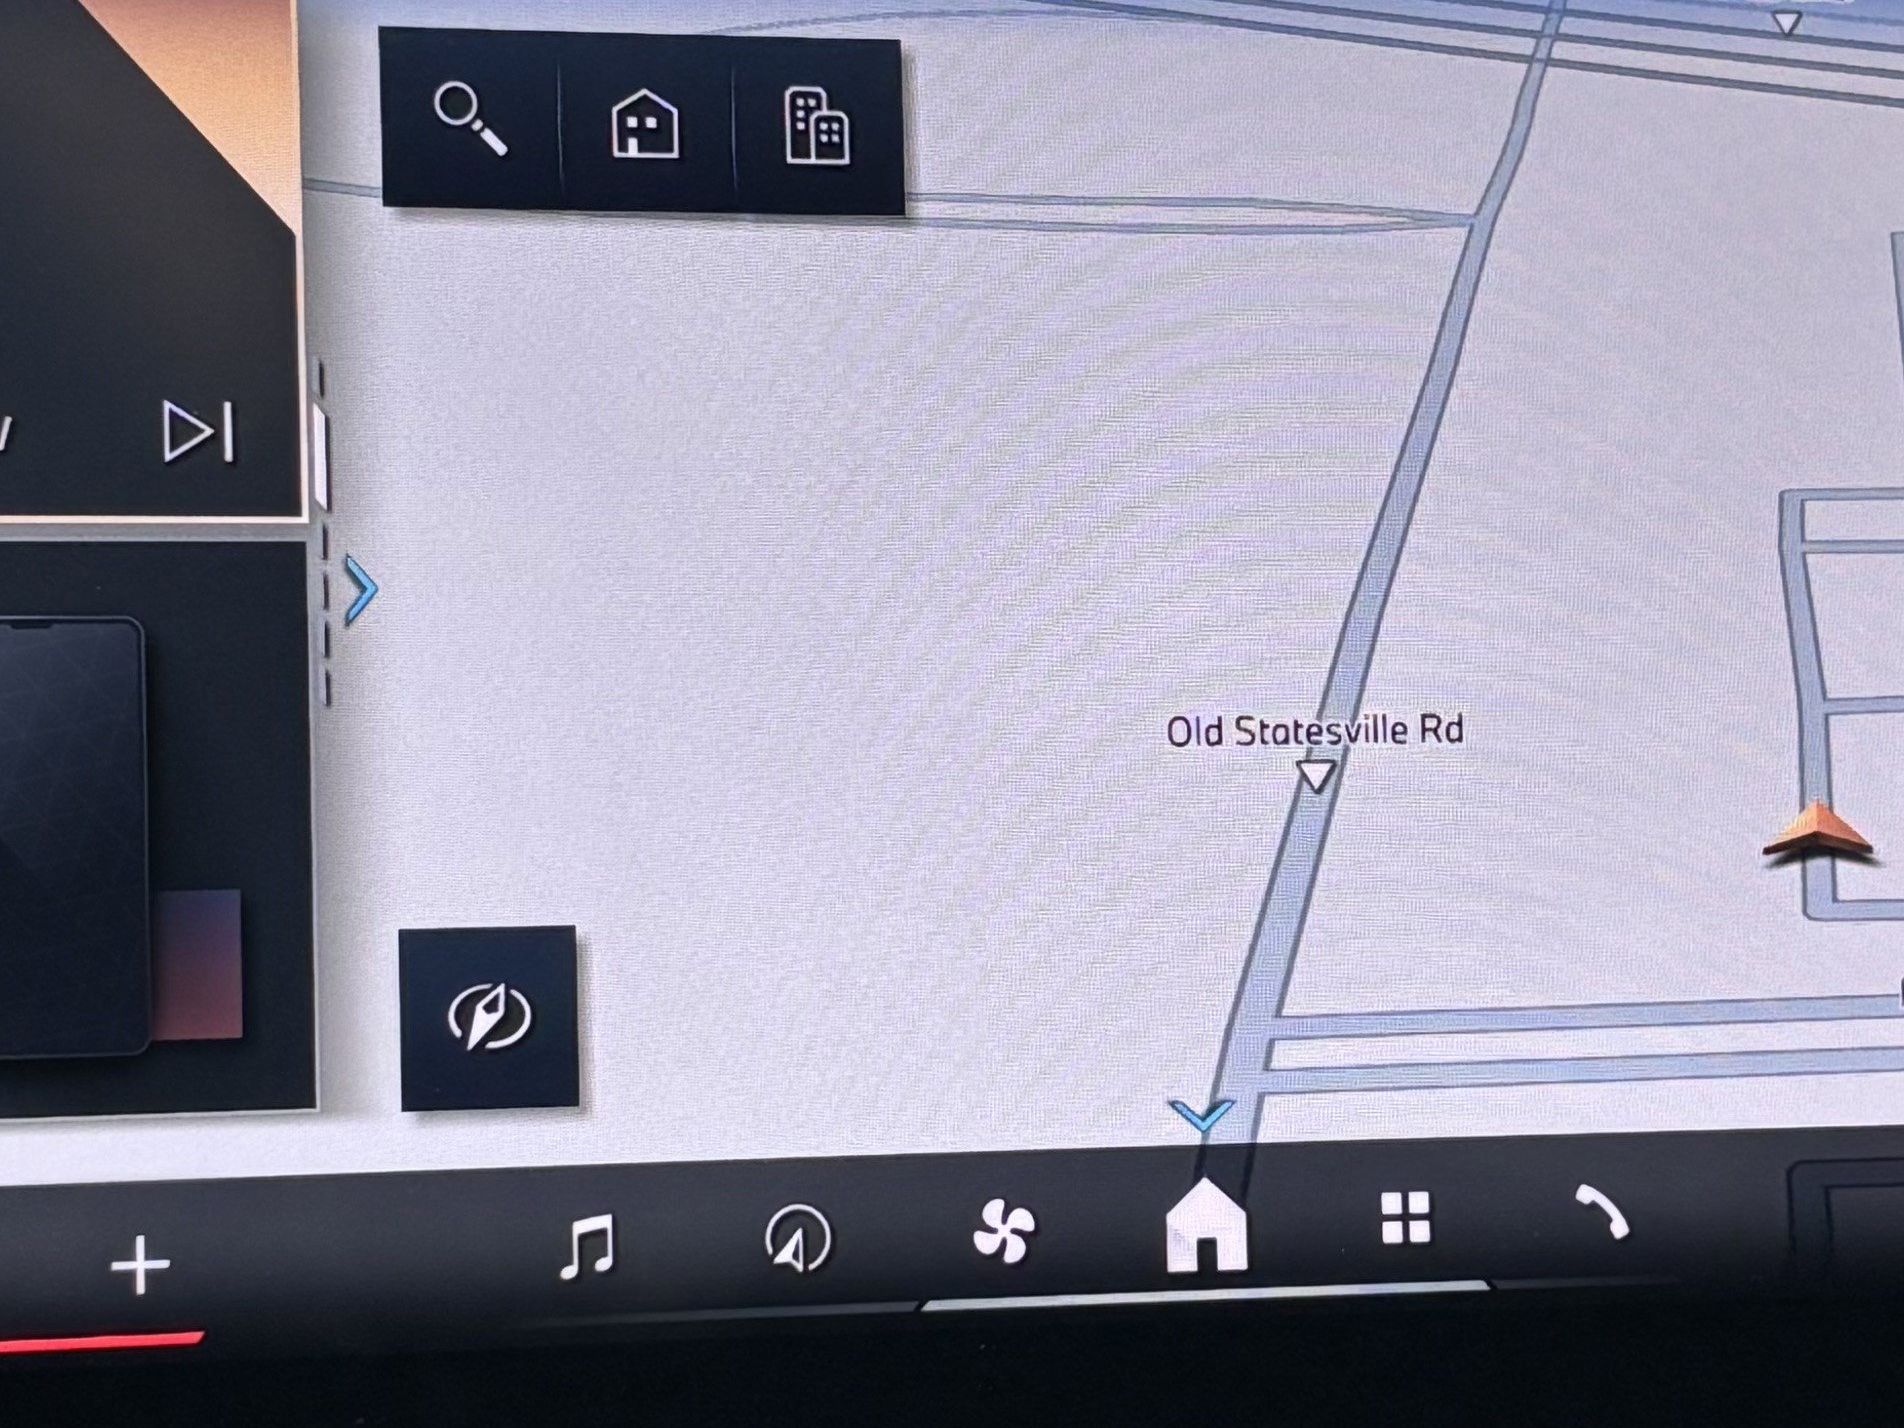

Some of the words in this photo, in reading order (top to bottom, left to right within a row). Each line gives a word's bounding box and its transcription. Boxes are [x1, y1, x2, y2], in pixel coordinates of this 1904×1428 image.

[1167, 715, 1223, 748] Old
[1234, 713, 1408, 746] Statesville
[1420, 711, 1464, 745] Rd
